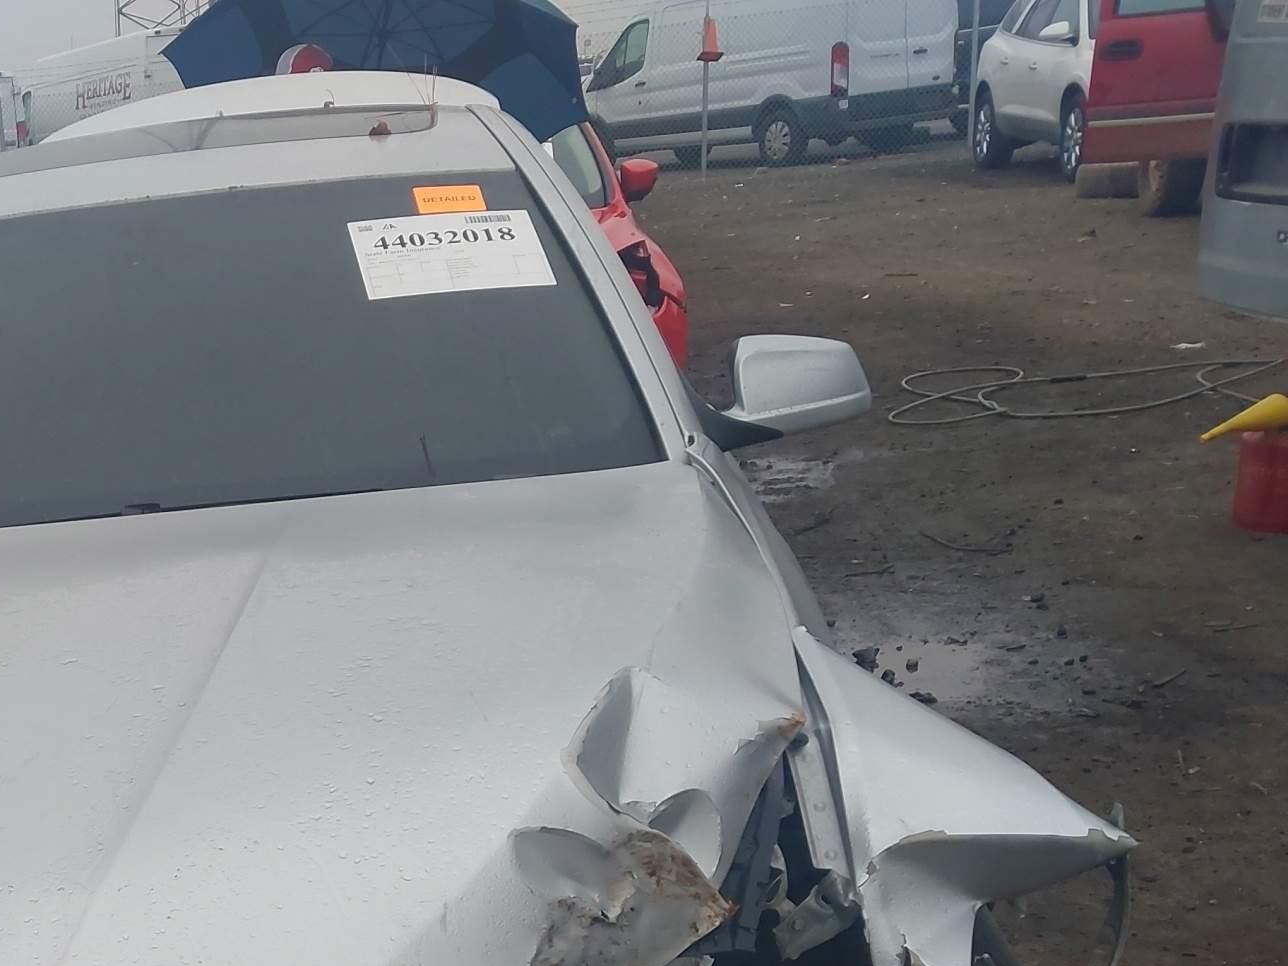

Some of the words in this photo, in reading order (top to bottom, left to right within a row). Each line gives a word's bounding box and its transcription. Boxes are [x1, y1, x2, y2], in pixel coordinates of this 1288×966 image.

[75, 72, 132, 110] HERITAGE
[421, 194, 477, 204] DETAILED
[373, 226, 516, 250] 44032018
